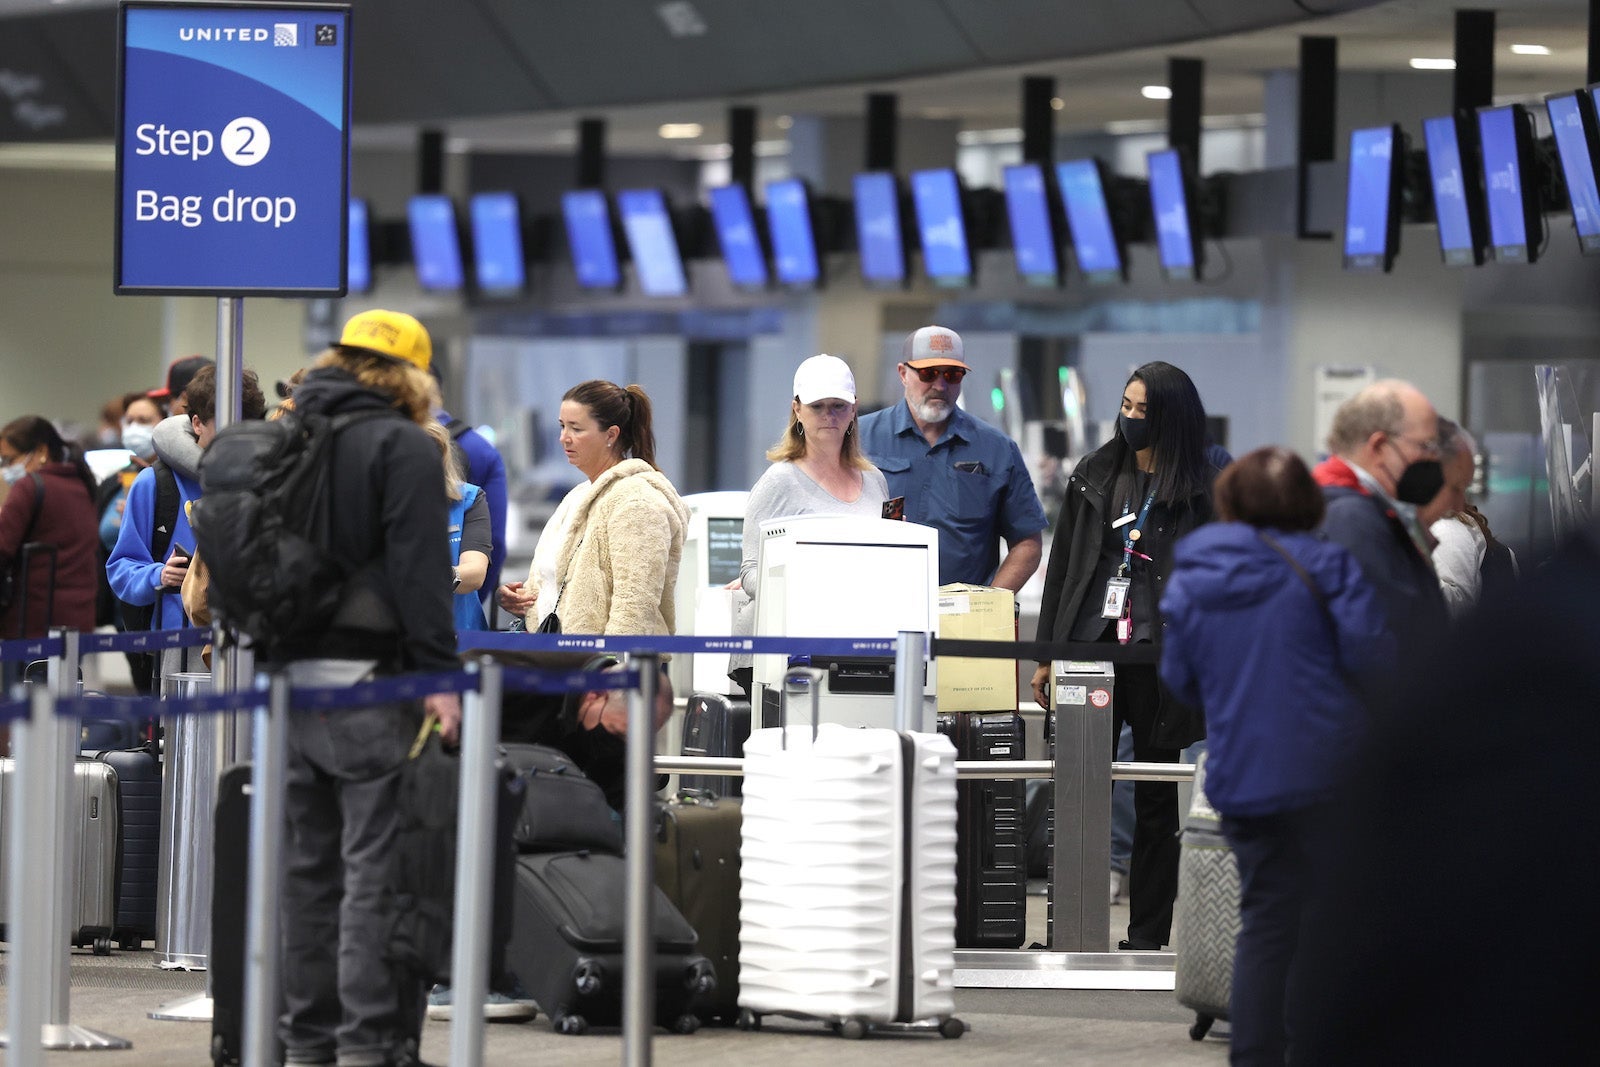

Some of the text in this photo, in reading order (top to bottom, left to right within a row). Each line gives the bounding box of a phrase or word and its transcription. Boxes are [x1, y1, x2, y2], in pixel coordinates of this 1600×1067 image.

[179, 28, 269, 41] UNITED
[135, 123, 255, 161] Step 2
[136, 189, 296, 228] Bag drop
[557, 639, 594, 647] UNITED
[705, 641, 742, 649] UNITED
[852, 642, 890, 650] UNITED
